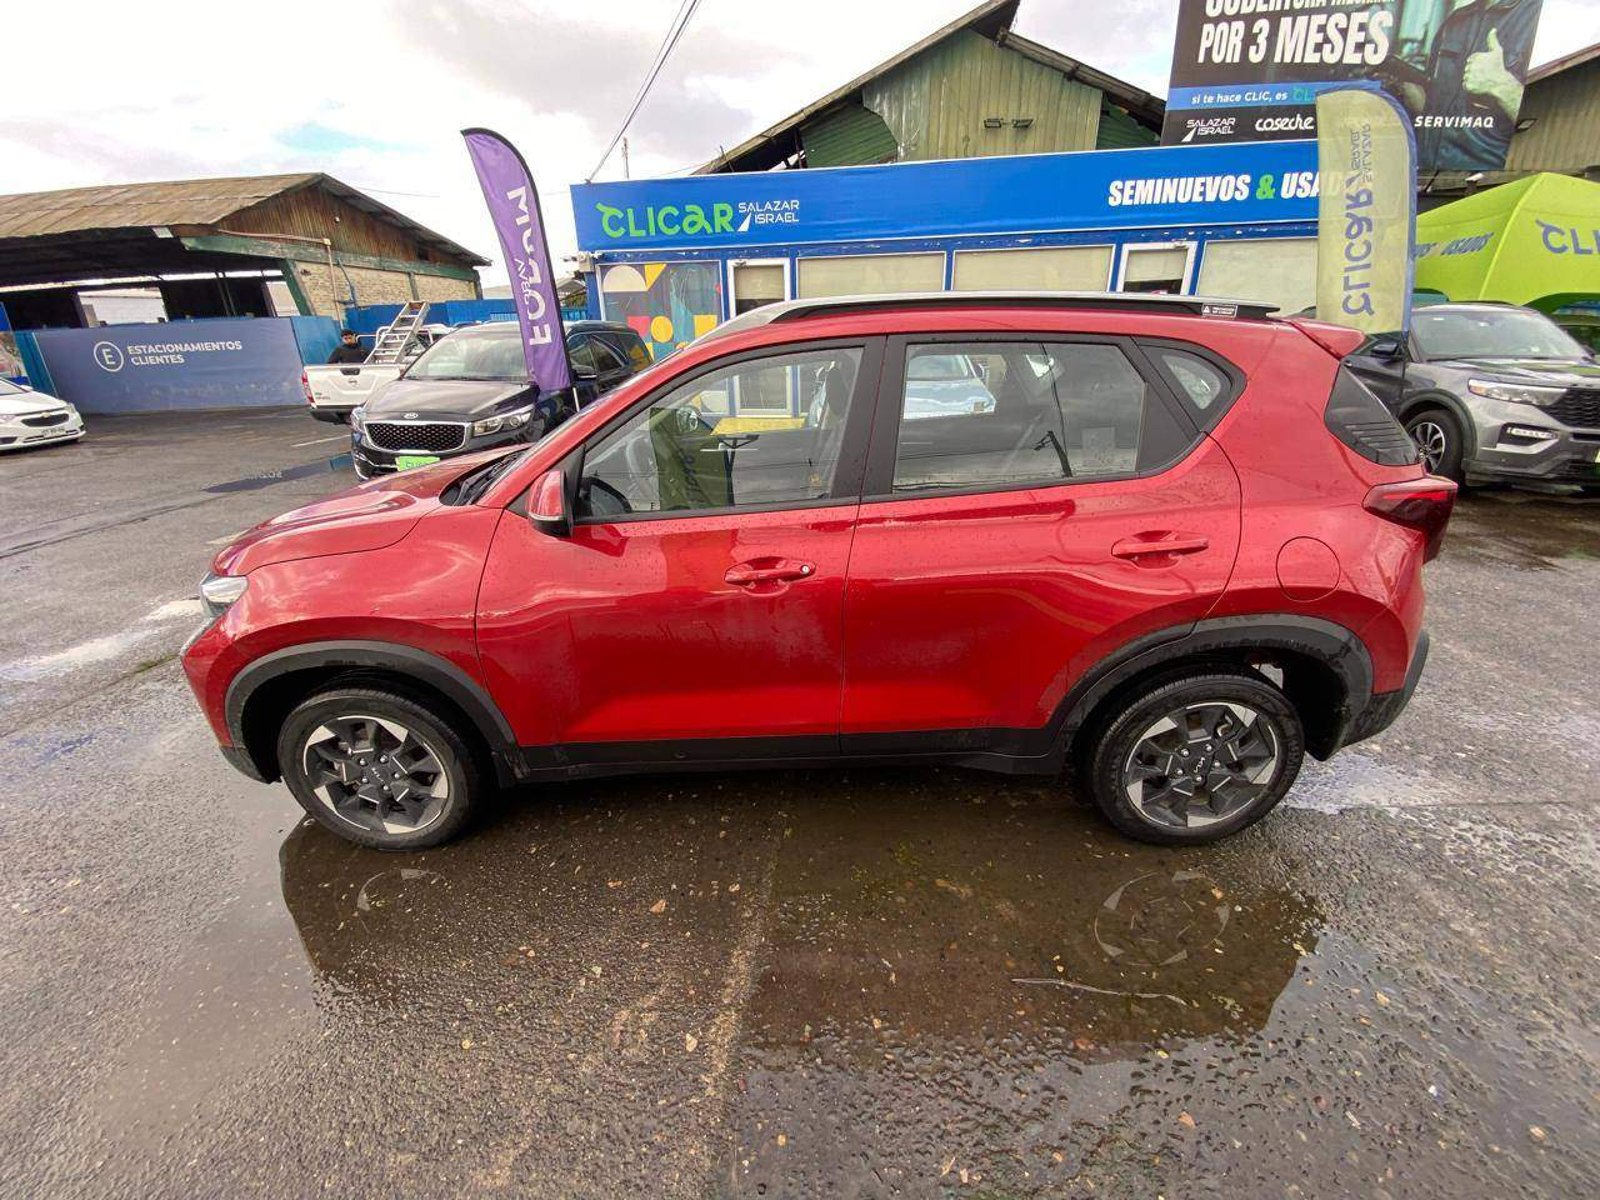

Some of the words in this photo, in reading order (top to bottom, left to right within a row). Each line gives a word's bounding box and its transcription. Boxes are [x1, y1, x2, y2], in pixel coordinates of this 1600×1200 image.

[1198, 19, 1245, 63] POR
[1248, 18, 1270, 63] 3
[1273, 11, 1394, 65] MESES
[1191, 95, 1200, 105] si
[1203, 93, 1213, 104] te
[1216, 93, 1241, 103] hace
[1244, 91, 1272, 102] CLIC,
[1275, 91, 1288, 101] es
[1186, 117, 1236, 128] SALAZAR
[1255, 114, 1315, 132] coseche
[1414, 115, 1495, 128] SERVIMAQ
[1196, 126, 1234, 136] ISRAEL
[1108, 174, 1251, 207] SEMINUEVOS
[1255, 174, 1276, 200] &
[738, 199, 800, 213] SALAZAR
[754, 212, 799, 225] ISRAEL
[1535, 219, 1600, 255] CLI
[127, 340, 243, 355] ESTACIONAMIENTOS
[101, 348, 116, 365] E
[130, 354, 185, 365] CLIENTES
